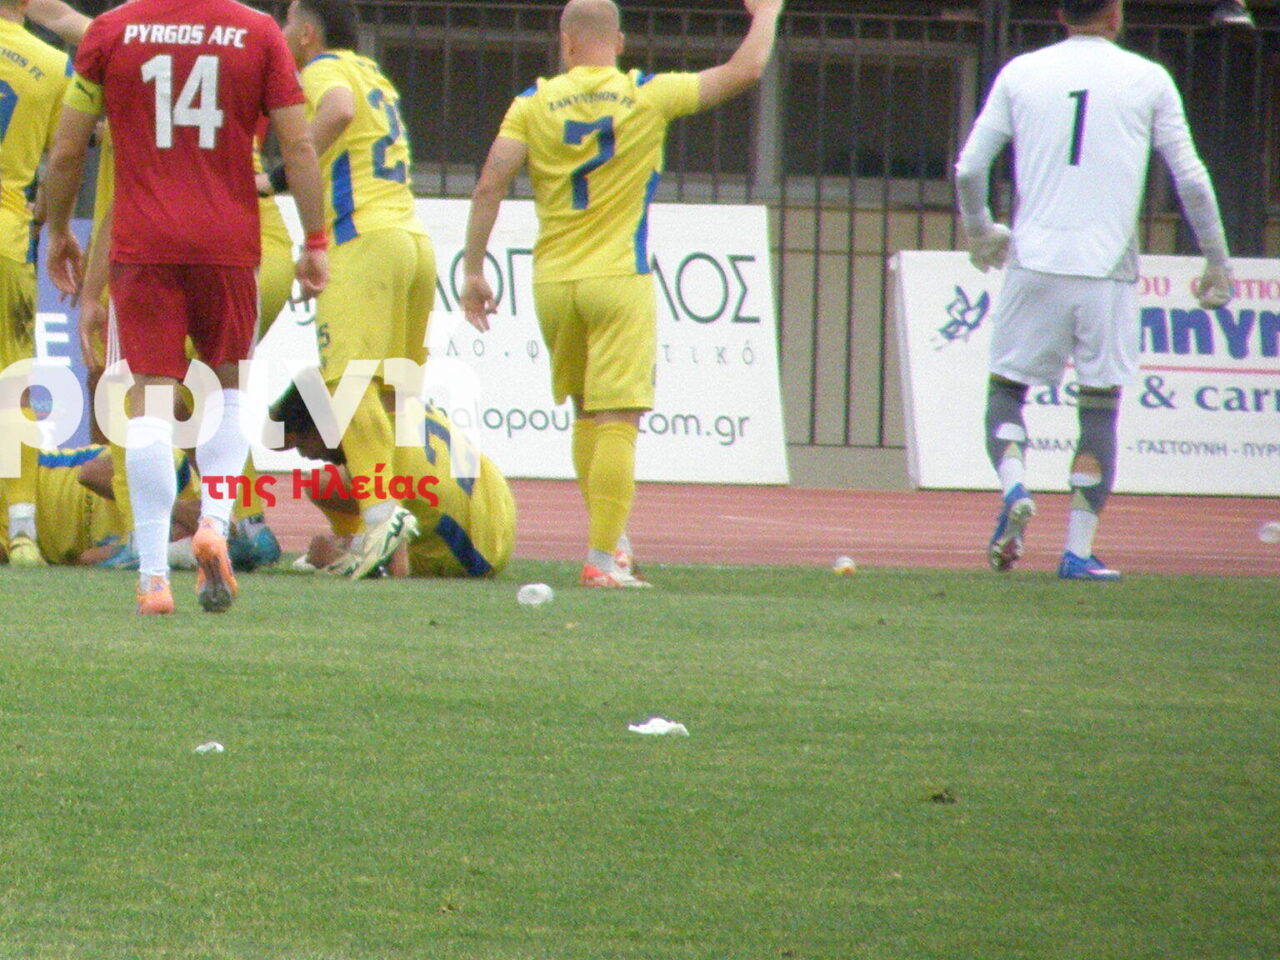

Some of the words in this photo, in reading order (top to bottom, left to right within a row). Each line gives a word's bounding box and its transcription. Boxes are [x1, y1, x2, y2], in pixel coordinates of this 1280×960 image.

[124, 24, 205, 45] PYRGOS
[207, 24, 248, 48] AFC
[140, 54, 224, 150] 14
[1068, 88, 1090, 166] 1
[563, 114, 616, 211] 7
[1139, 374, 1177, 410] &
[1137, 440, 1228, 456] ΓΑΣΤΟΥΝΗ
[1242, 443, 1280, 458] ΠΥΡ
